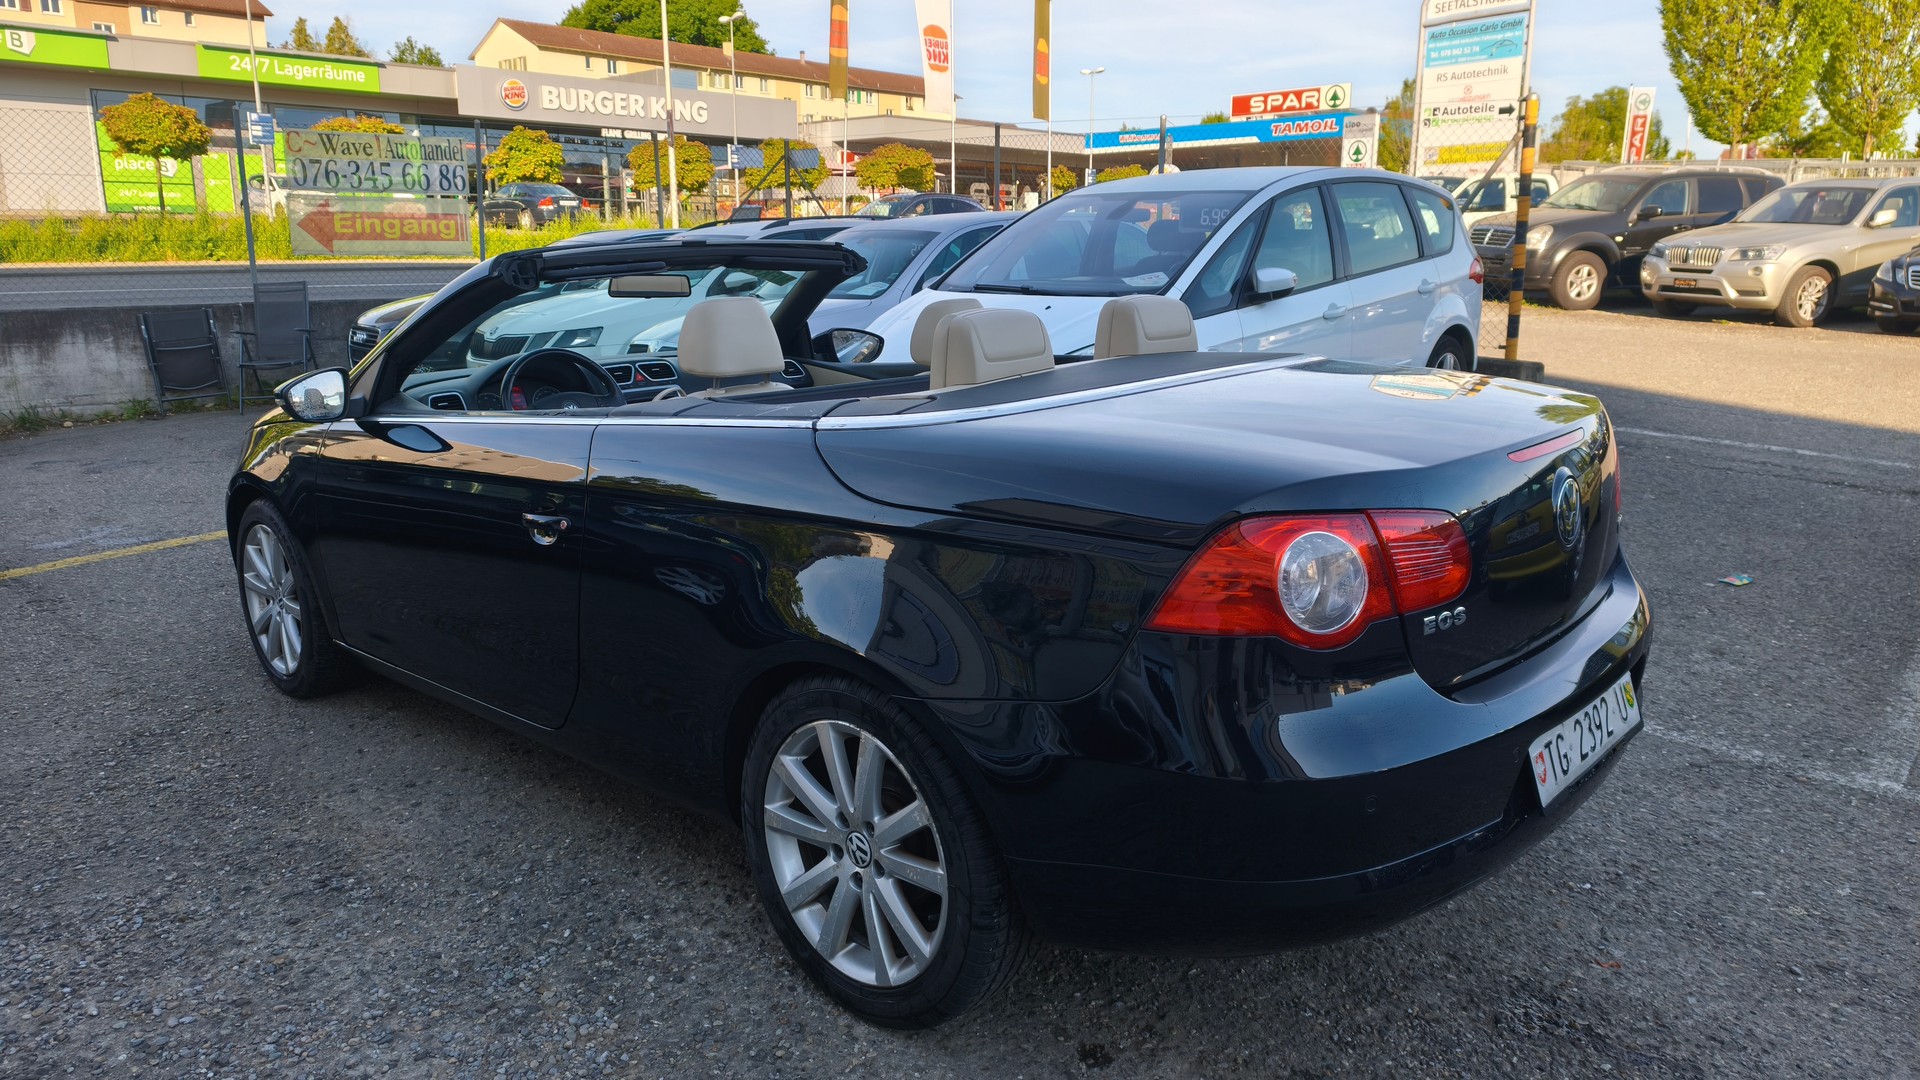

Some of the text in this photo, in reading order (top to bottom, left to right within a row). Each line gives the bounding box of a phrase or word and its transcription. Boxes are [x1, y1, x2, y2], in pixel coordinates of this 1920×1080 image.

[1429, 18, 1524, 40] Auto Occasion Carlo GmbH
[274, 59, 366, 83] Lagerräume
[1436, 65, 1509, 82] RS Autotechnik
[504, 91, 526, 100] KING
[540, 85, 709, 125] BURGER KNG
[1250, 90, 1321, 113] SPAR
[1442, 102, 1496, 116] Autoteile
[1271, 118, 1338, 137] TAMOIL
[385, 137, 465, 162] Autohandel
[115, 157, 155, 171] place
[293, 158, 466, 191] 076-345 66 86
[333, 212, 457, 240] Eingang
[1423, 606, 1467, 636] EOS
[1544, 732, 1570, 783] TG
[1573, 696, 1614, 763] 2392
[1613, 685, 1629, 722] U
